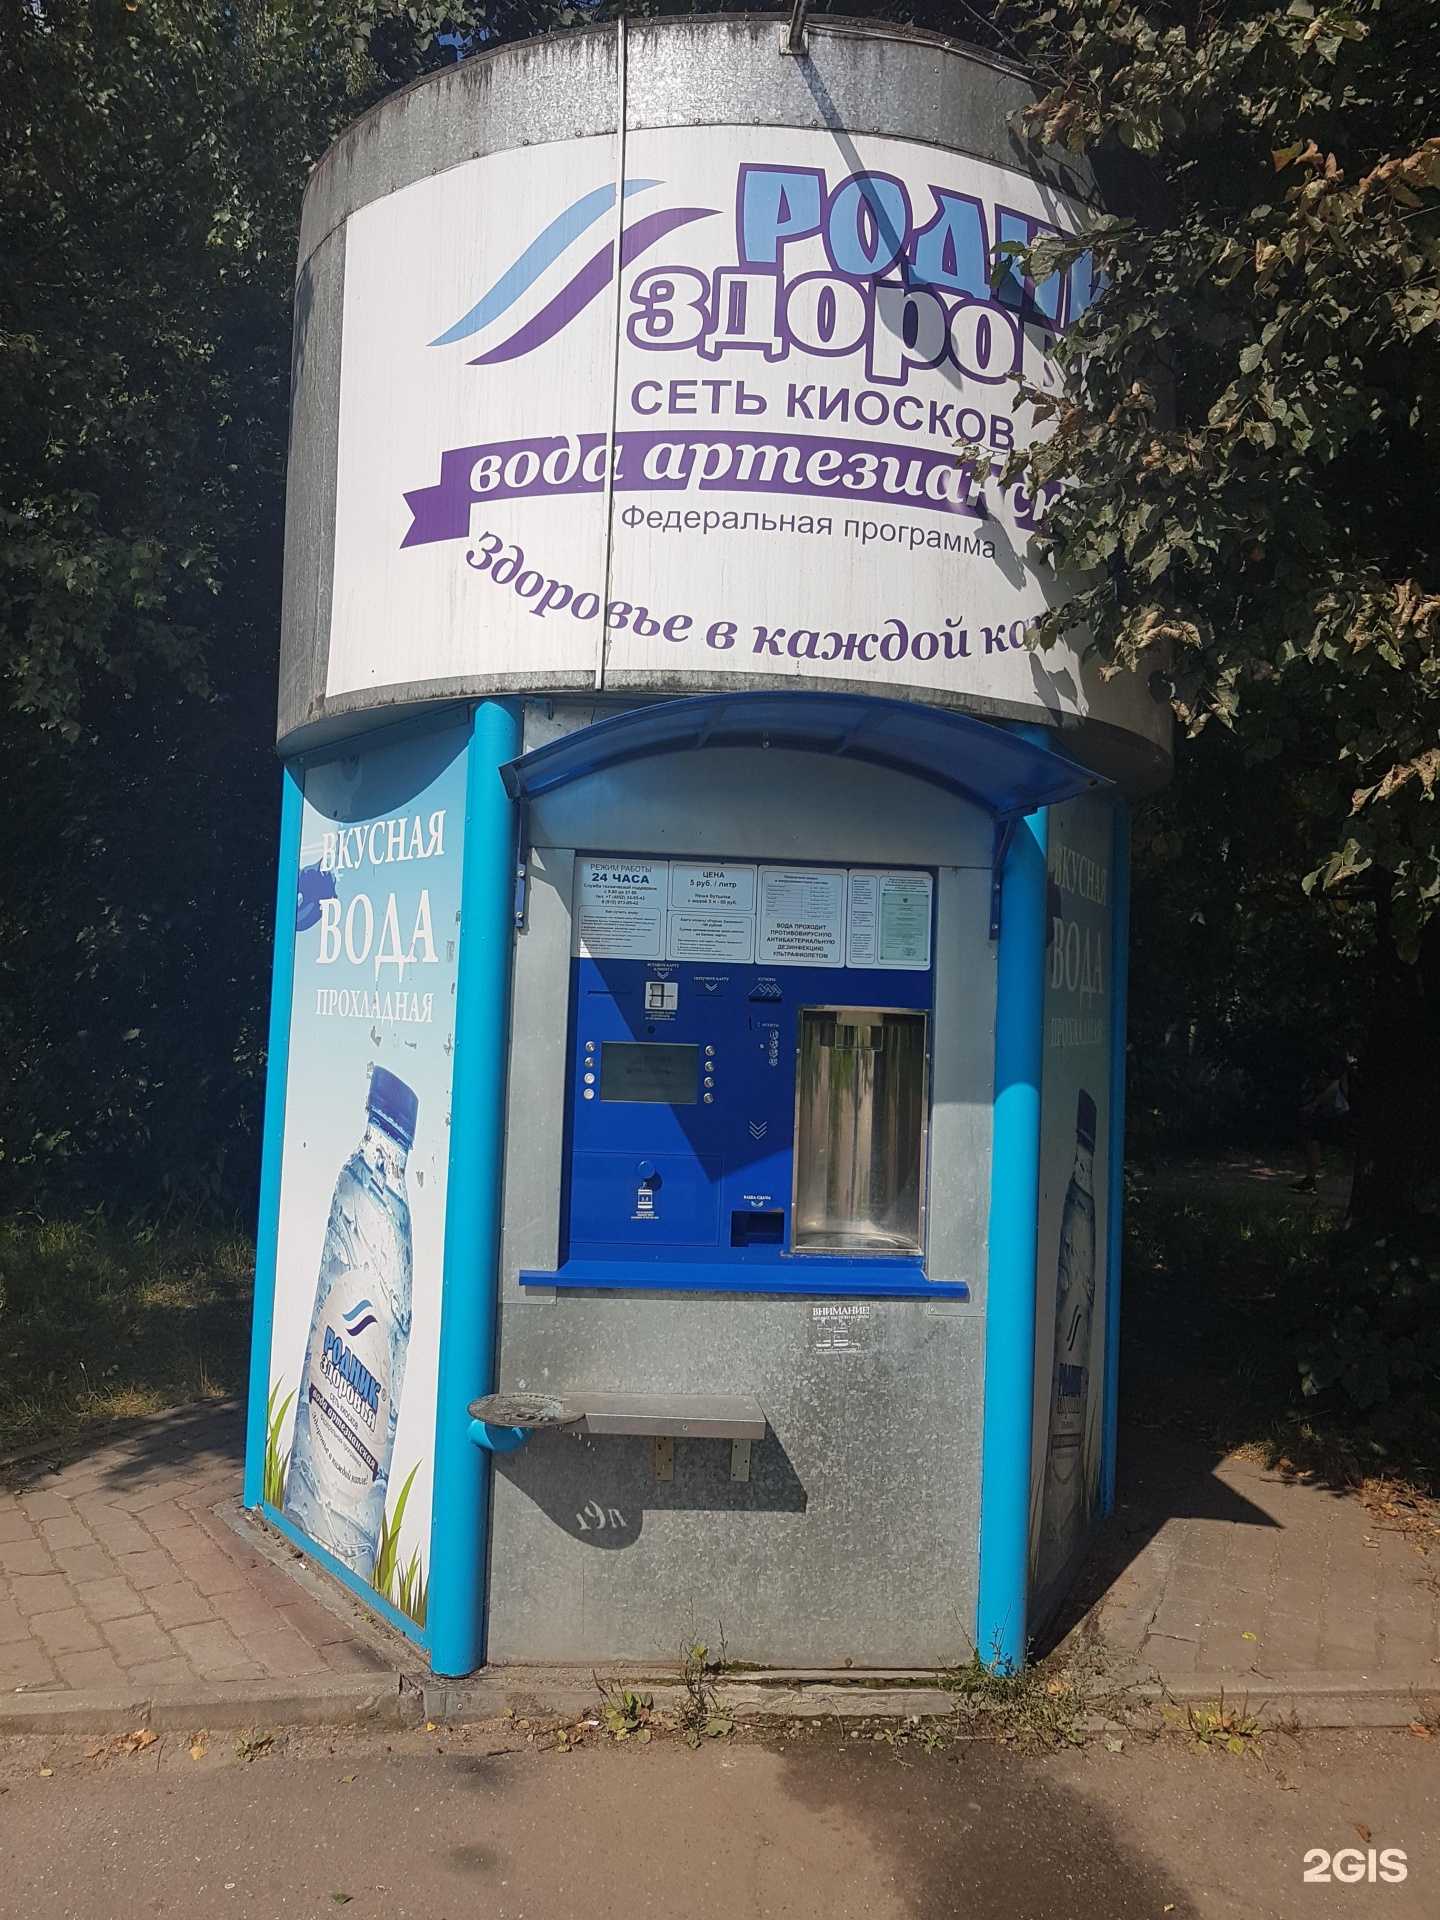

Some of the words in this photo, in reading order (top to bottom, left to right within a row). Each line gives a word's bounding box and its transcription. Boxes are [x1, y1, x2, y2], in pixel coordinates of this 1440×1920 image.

[631, 379, 768, 416] СЕТЬ
[787, 384, 1015, 451] КИОСКОВ
[470, 434, 624, 494] вода
[621, 505, 833, 538] Федеральная
[844, 518, 997, 558] программа
[465, 530, 693, 642] Здоровье
[706, 619, 738, 650] в
[752, 616, 972, 661] каждой
[320, 809, 446, 872] ВКУСНАЯ
[620, 865, 652, 873] РАБОТЫ
[591, 872, 608, 882] 24
[612, 873, 649, 884] ЧАСА
[696, 880, 712, 888] руб.
[702, 871, 725, 879] ЦЕНА
[316, 889, 440, 983] ВОДА
[1051, 916, 1105, 1009] ВОДА
[315, 988, 435, 1026] ПРОХЛАДНАЯ
[323, 1325, 382, 1414] РОДНИК
[327, 1405, 376, 1469] артезианская
